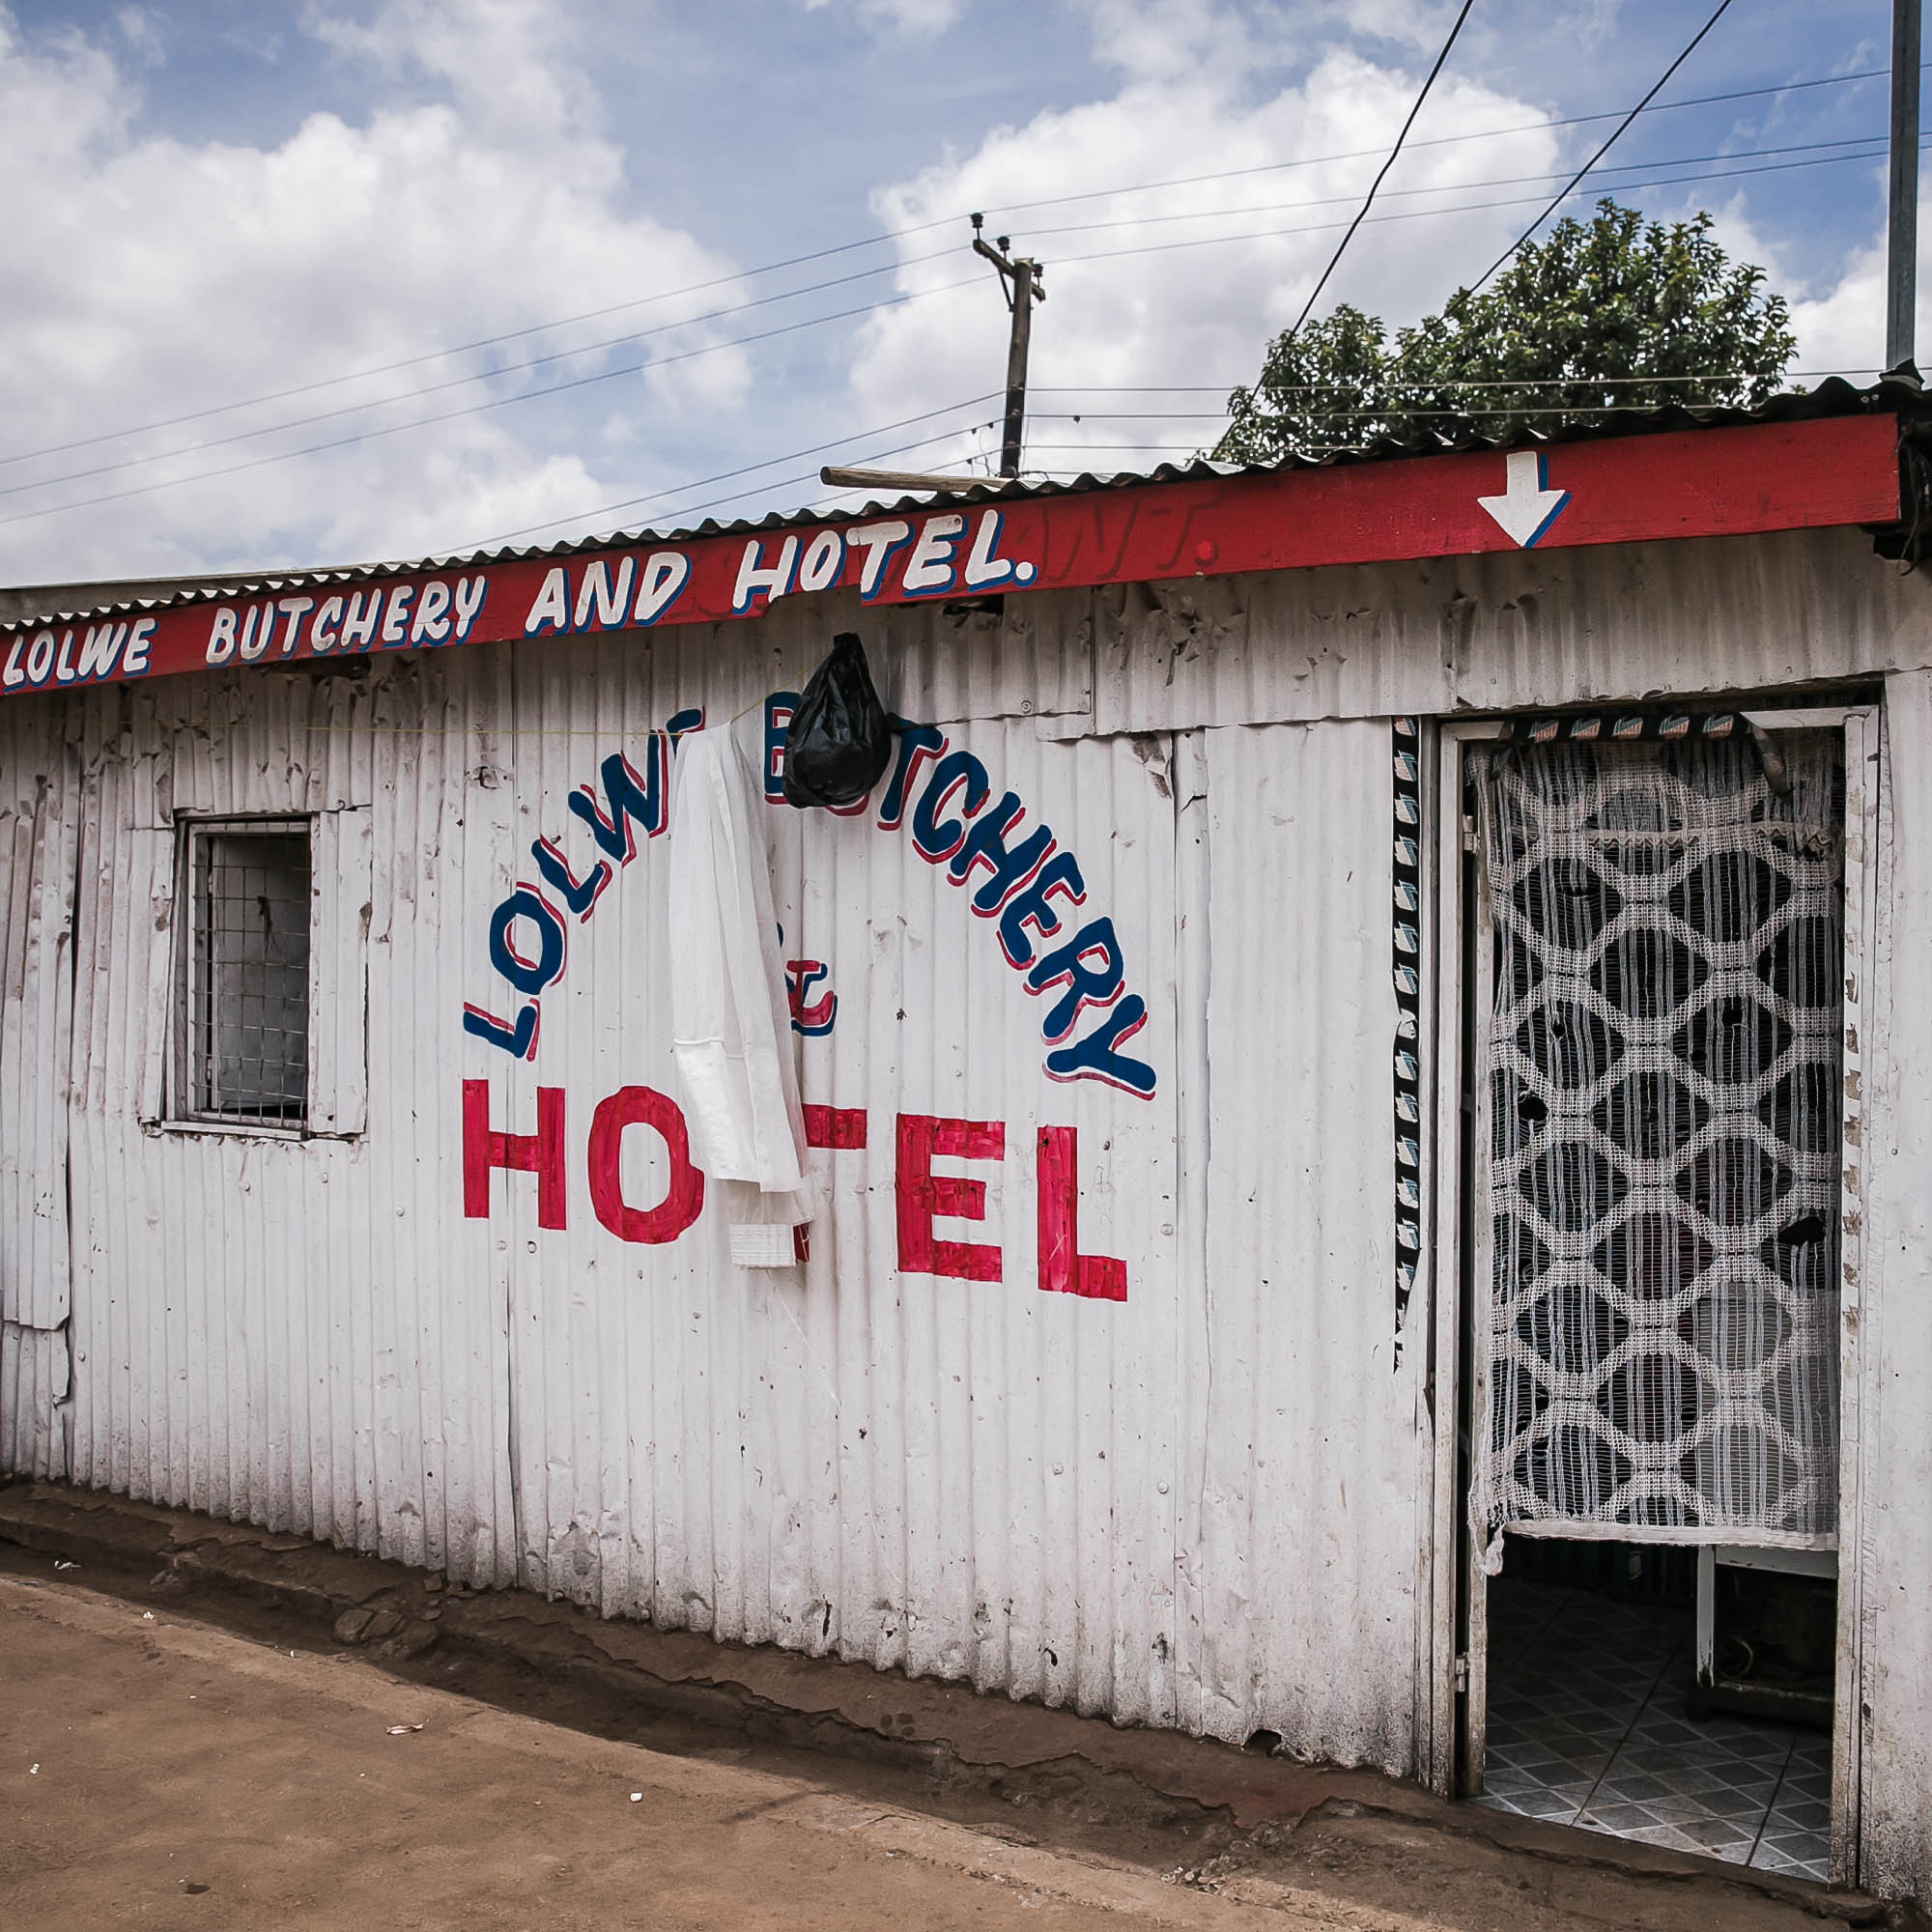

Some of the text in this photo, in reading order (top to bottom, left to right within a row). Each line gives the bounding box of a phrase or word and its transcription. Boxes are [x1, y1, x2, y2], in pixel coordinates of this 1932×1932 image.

[3, 618, 159, 694] LOLWE
[206, 575, 487, 668] BUTCHERY
[525, 551, 691, 638] AND
[731, 509, 1038, 615] HOTEL.
[463, 704, 706, 1063] LOLW
